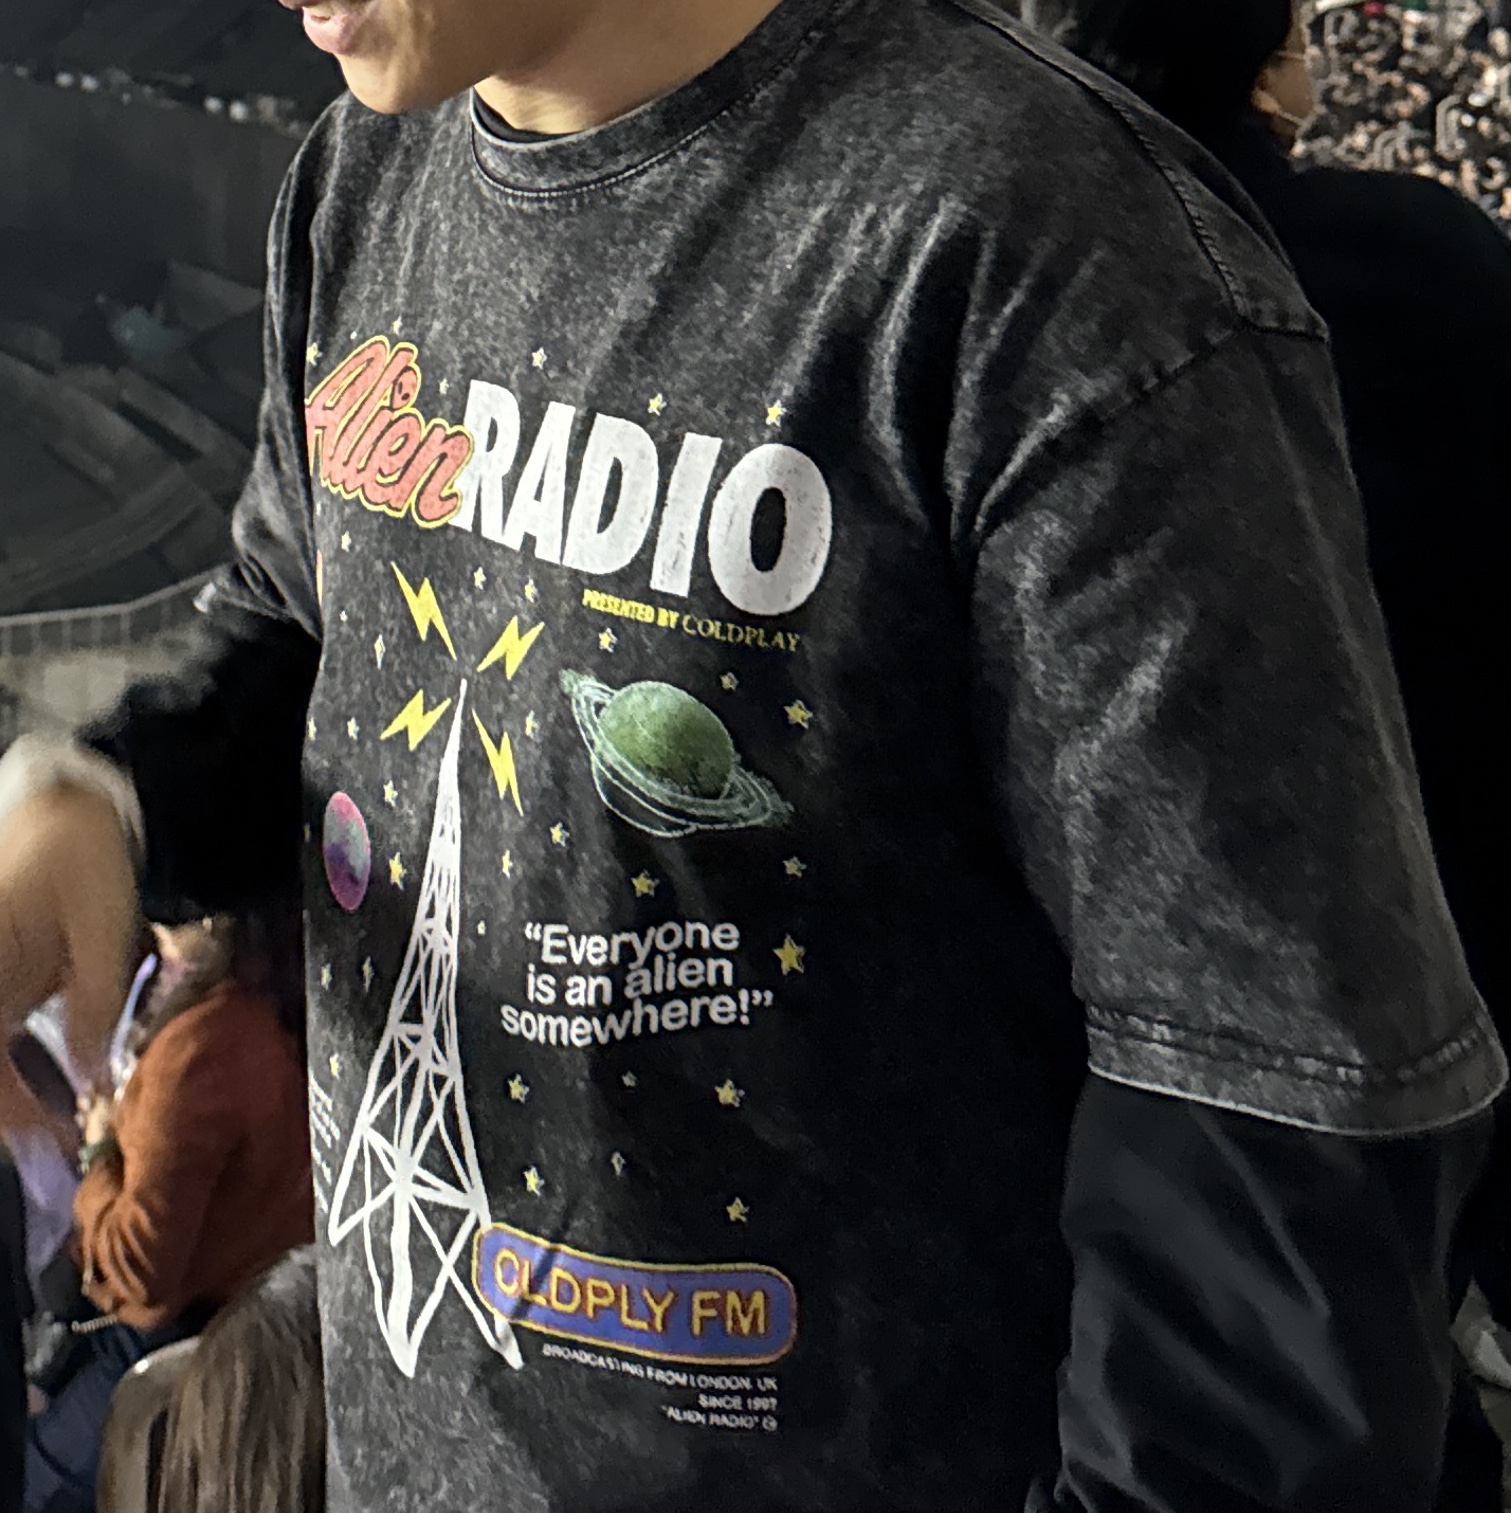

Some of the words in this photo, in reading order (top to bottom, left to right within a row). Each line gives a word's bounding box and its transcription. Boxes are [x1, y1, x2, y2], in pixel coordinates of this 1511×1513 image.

[305, 335, 476, 529] Alien
[449, 379, 832, 616] RADIO
[582, 589, 655, 624] PRESENTED
[657, 606, 681, 629] BY
[682, 614, 800, 653] COLDPLAY
[525, 921, 741, 970] “Everyone
[525, 963, 557, 1005] is
[564, 973, 613, 1007] an
[623, 951, 734, 1000] alien
[500, 988, 775, 1048] somewhere!”
[691, 1289, 766, 1336] FM
[542, 1343, 645, 1379] BROADCASTING
[646, 1366, 688, 1387] FROM
[756, 1376, 779, 1392] UK
[697, 1393, 743, 1411] SINCE
